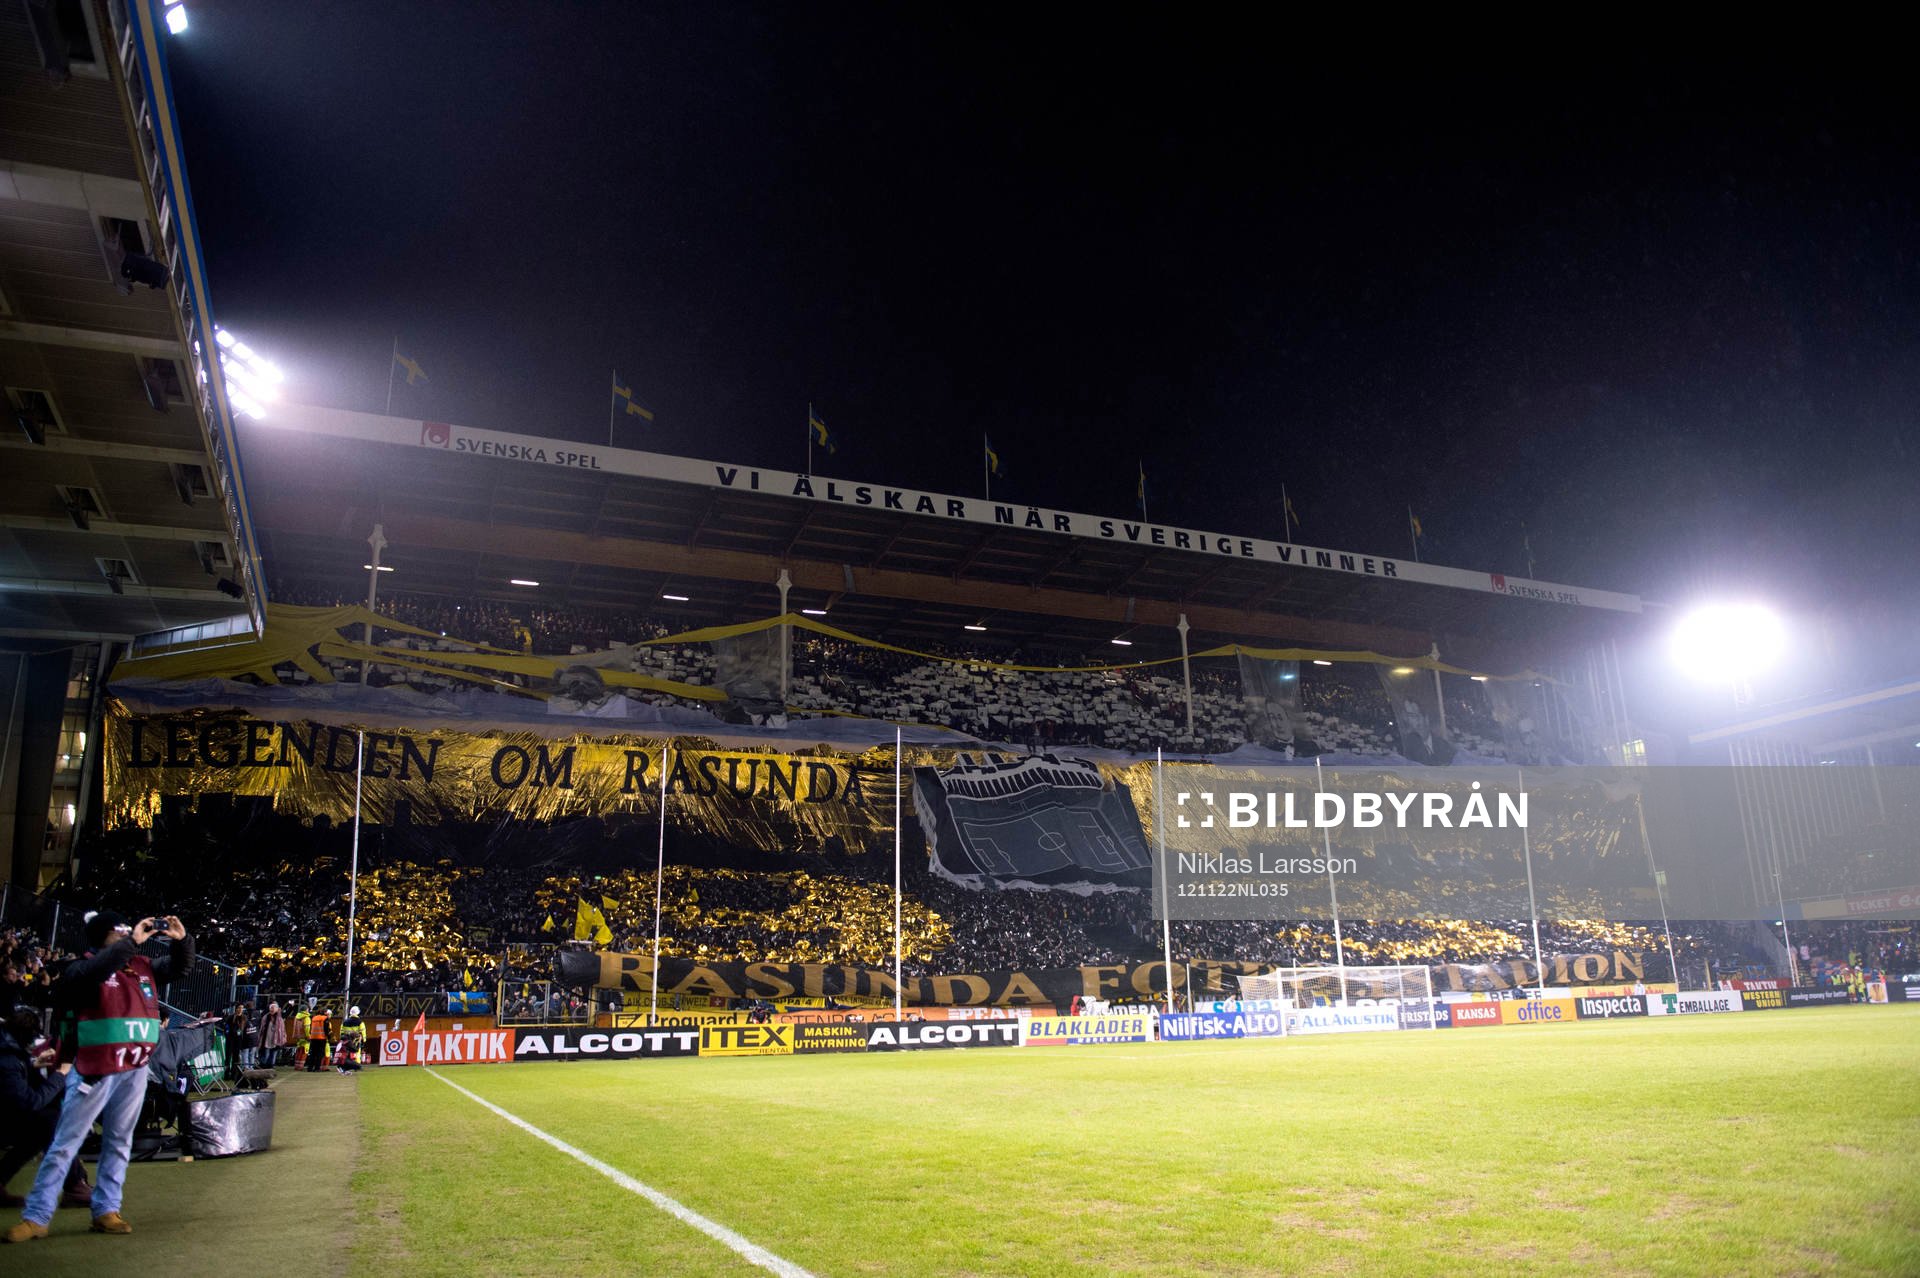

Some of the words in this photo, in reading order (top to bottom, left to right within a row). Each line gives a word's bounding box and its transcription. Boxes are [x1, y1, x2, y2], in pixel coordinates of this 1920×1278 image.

[455, 437, 547, 463] SVENSKA
[555, 450, 602, 470] SPEL
[715, 465, 760, 490] VI
[793, 473, 965, 518] ÄLSKAR
[995, 505, 1072, 533] NÄR
[1100, 520, 1254, 557] SVERIGE
[1277, 545, 1397, 577] VINNER
[1509, 584, 1555, 600] SVENSKA
[1558, 591, 1581, 604] SPEL
[127, 718, 445, 783] LEGENDEN
[490, 744, 577, 790] OM
[619, 740, 867, 808] RÅSUNDA
[1848, 898, 1891, 911] TICKET
[592, 951, 1053, 1008] RÅSUNDA
[1743, 990, 1780, 1000] WESTERN
[1756, 999, 1781, 1008] UNION
[1457, 1007, 1496, 1020] KANSAS
[1518, 1002, 1561, 1021] office
[1582, 996, 1641, 1017] Inspecta
[1680, 999, 1730, 1013] EMBALLAGE
[646, 1012, 738, 1027] Proguard
[1163, 1013, 1278, 1037] Nilfisk-ALTO
[1401, 1010, 1449, 1022] FRISTDS
[124, 1021, 150, 1040] TV
[702, 1024, 789, 1049] ITEX
[804, 1027, 857, 1038] MASKIN-
[868, 1023, 1019, 1046] ALCOTT
[414, 1033, 507, 1062] TAKTIK
[515, 1031, 699, 1055] ALCOTT
[794, 1038, 867, 1049] UTHYRNING
